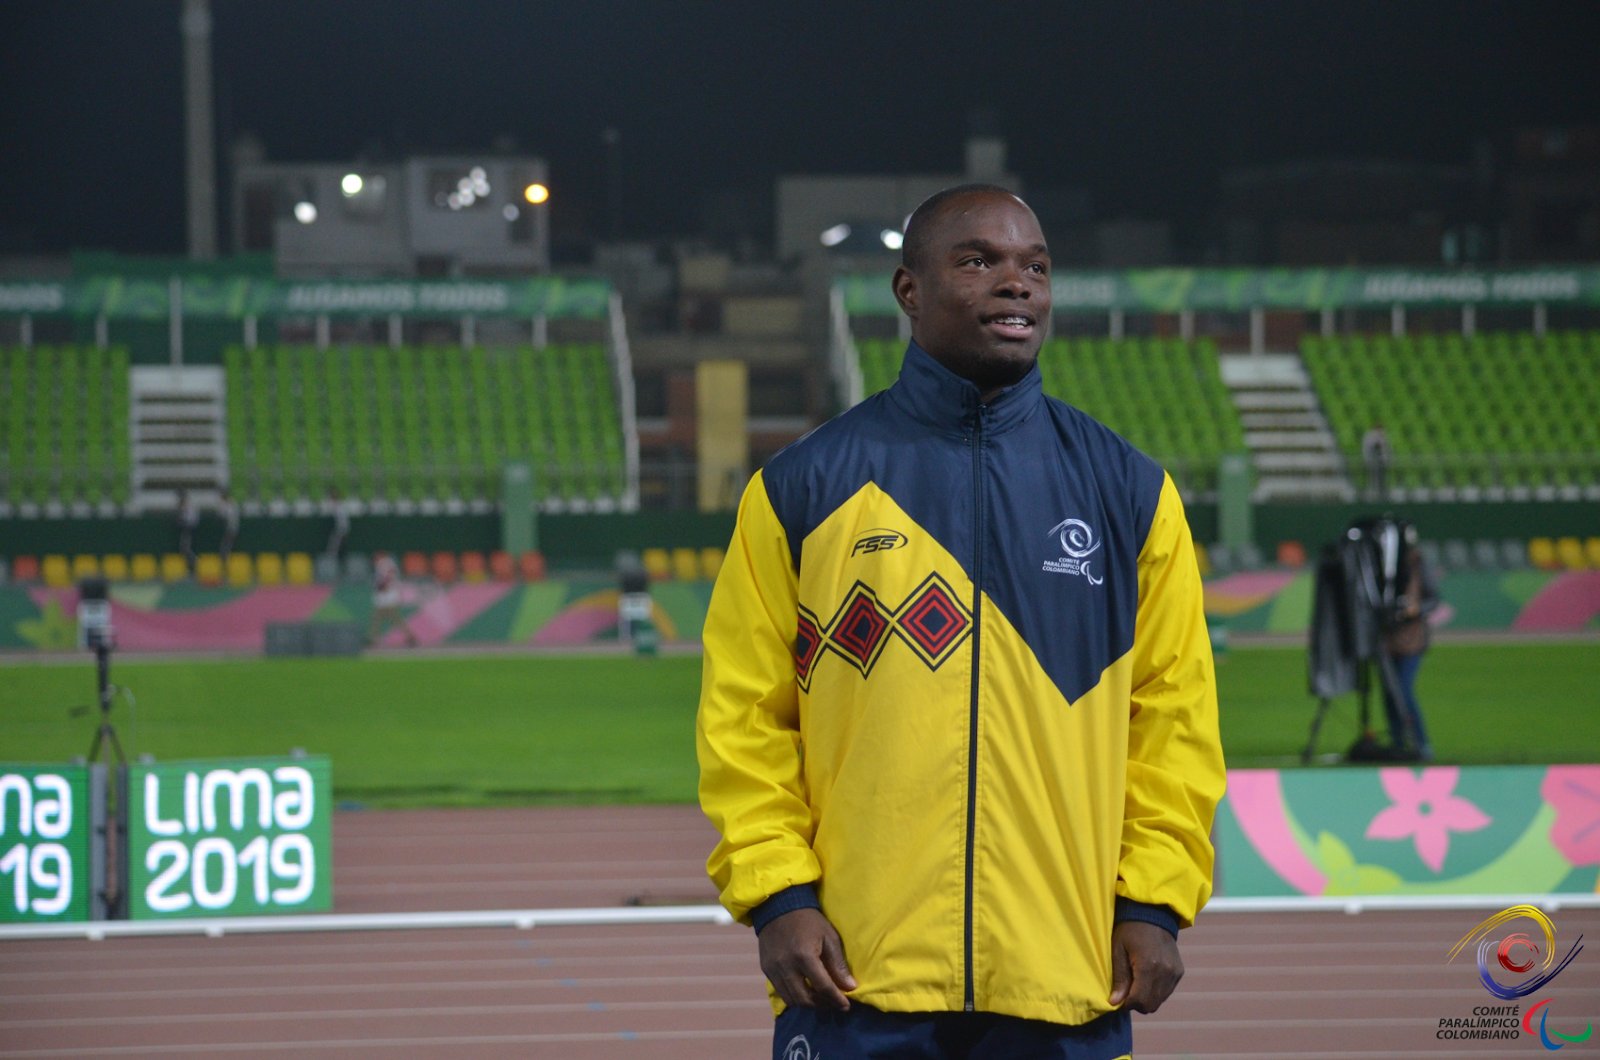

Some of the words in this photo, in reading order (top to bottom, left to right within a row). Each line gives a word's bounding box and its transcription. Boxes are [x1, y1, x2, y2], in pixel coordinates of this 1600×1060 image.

[851, 535, 899, 558] FSS
[1042, 565, 1080, 576] COLOMBIANO
[145, 833, 315, 912] 2019
